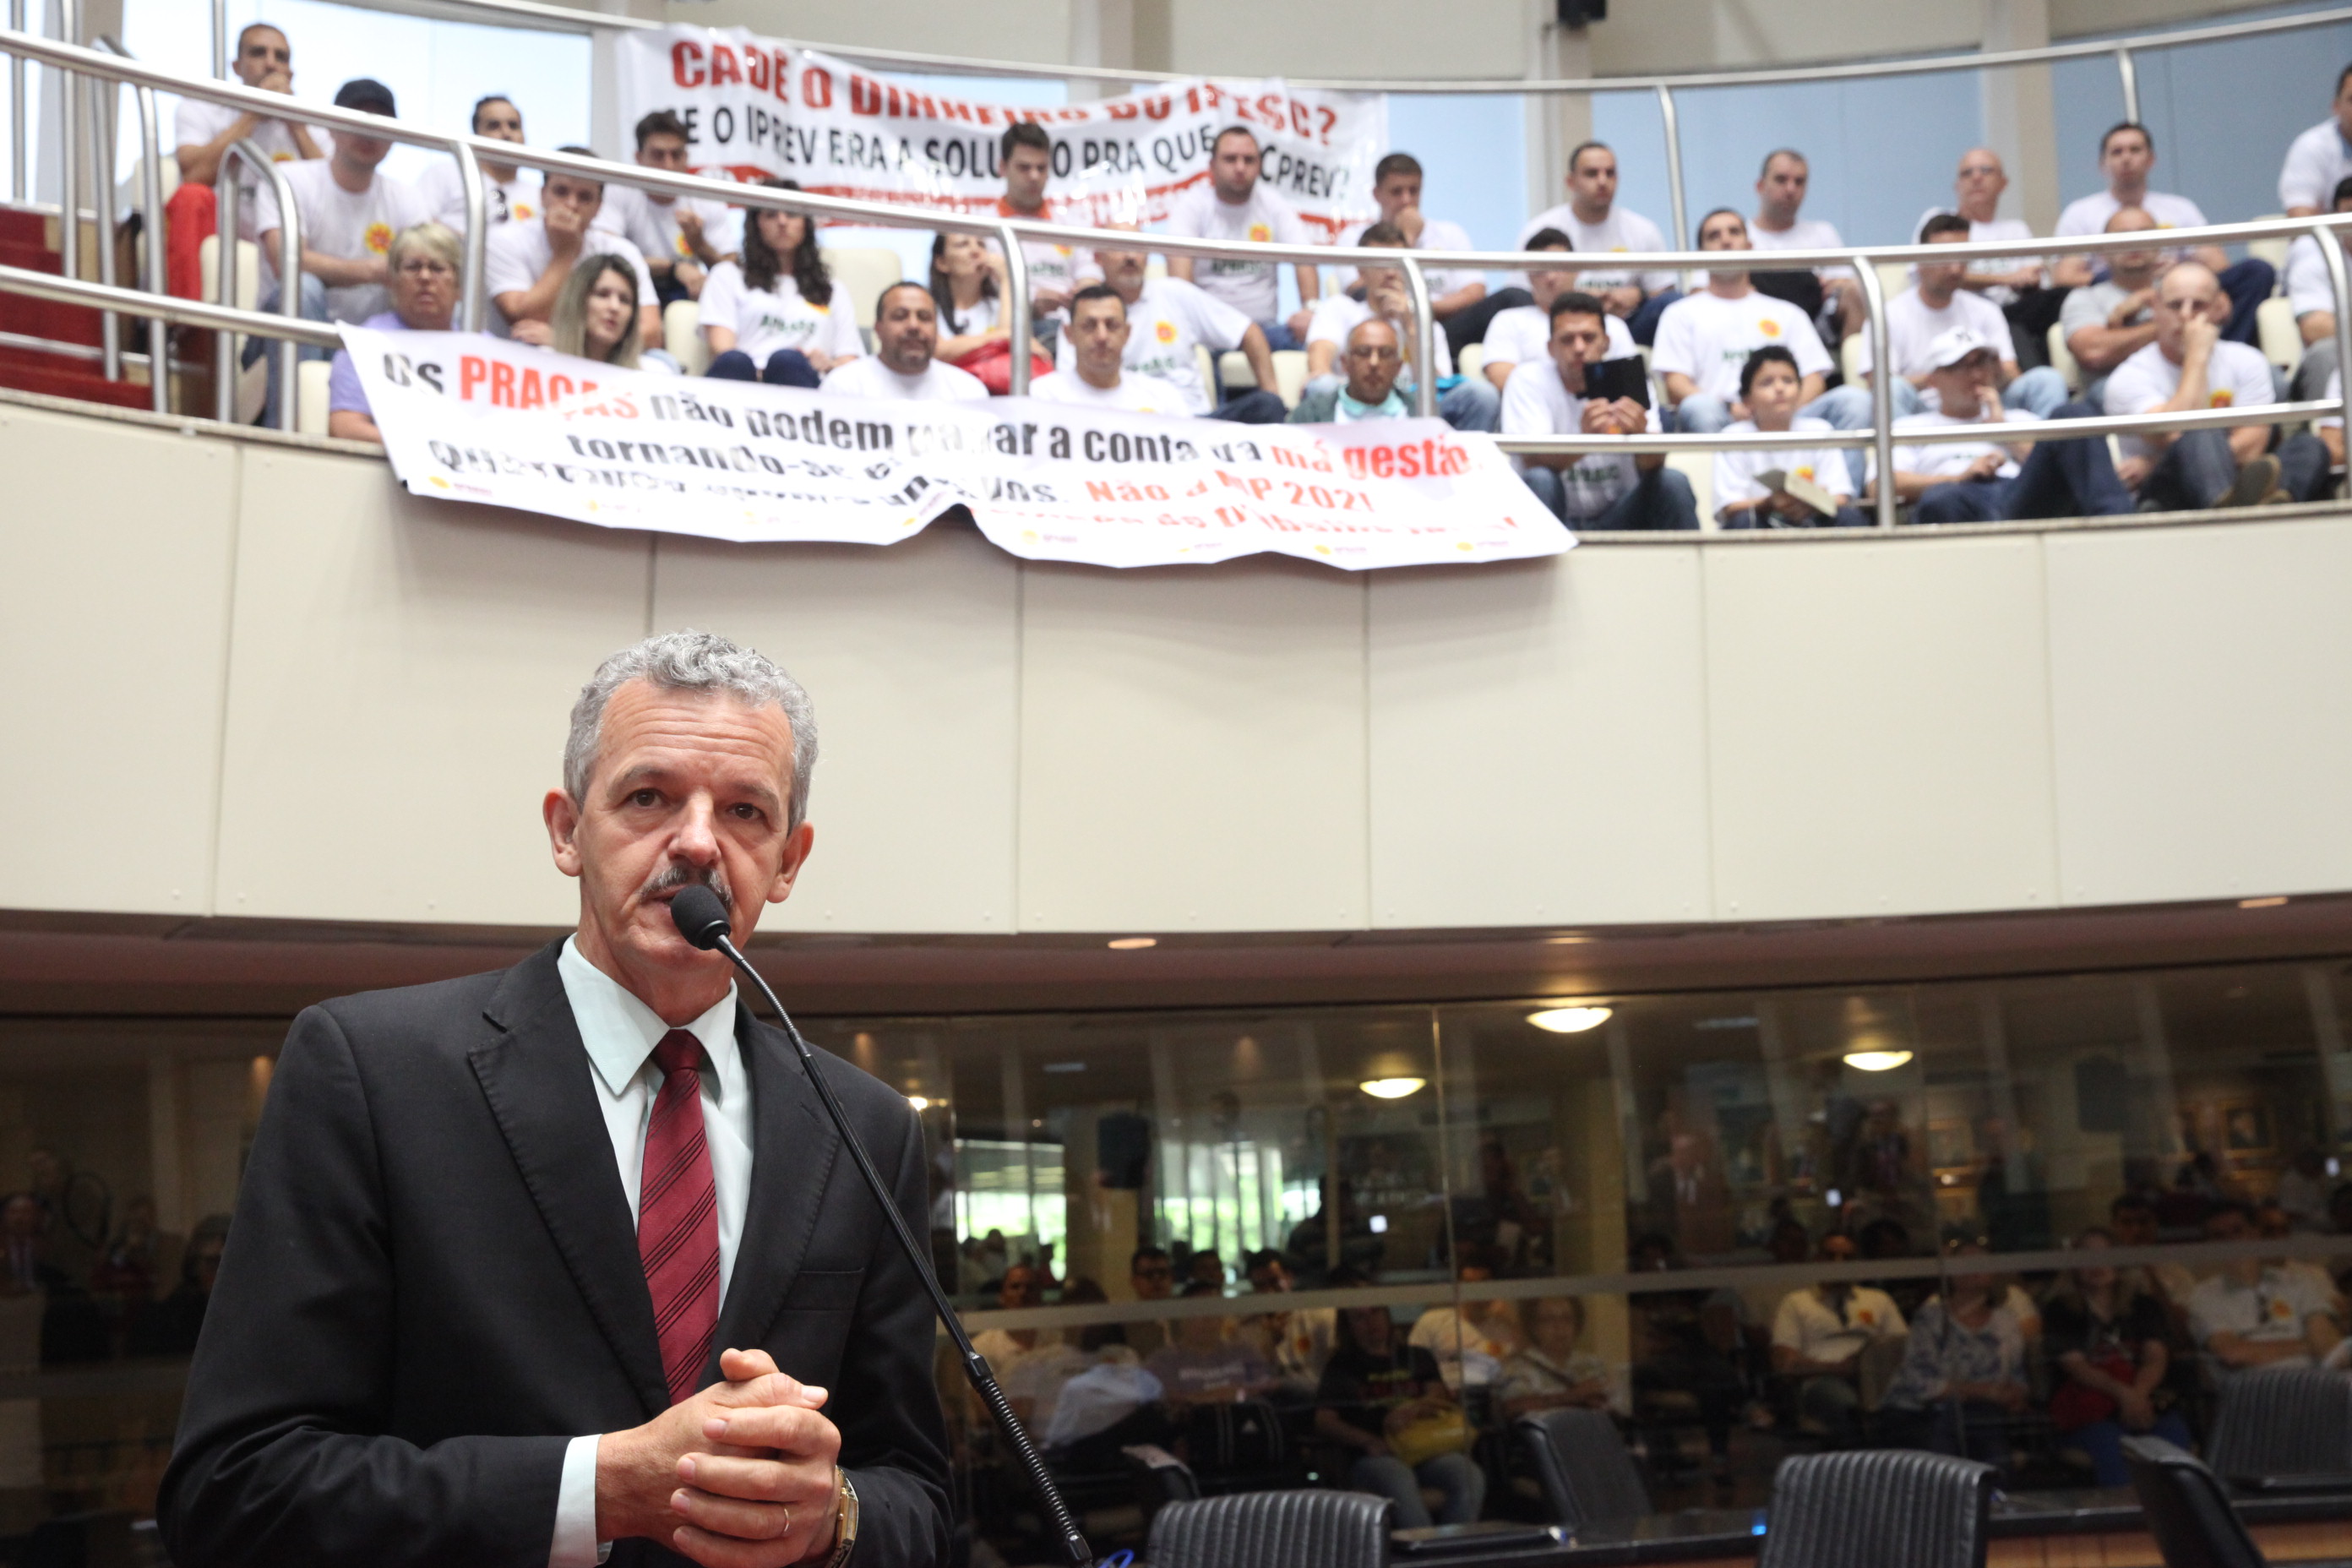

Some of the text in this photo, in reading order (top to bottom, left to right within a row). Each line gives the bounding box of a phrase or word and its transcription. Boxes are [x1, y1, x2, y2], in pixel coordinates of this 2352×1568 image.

[802, 67, 832, 108] O
[714, 106, 733, 143] O
[747, 105, 816, 164] IPREV
[830, 129, 887, 171] ERA
[925, 139, 1071, 178] SOLUO
[1083, 139, 1146, 174] PRA
[1154, 125, 1217, 173] QUE
[460, 354, 640, 421] PRAÇAS
[650, 391, 735, 427] não
[907, 422, 1038, 457] paar
[1050, 424, 1071, 460] a
[1084, 429, 1200, 464] conta
[1086, 477, 1170, 502] Não
